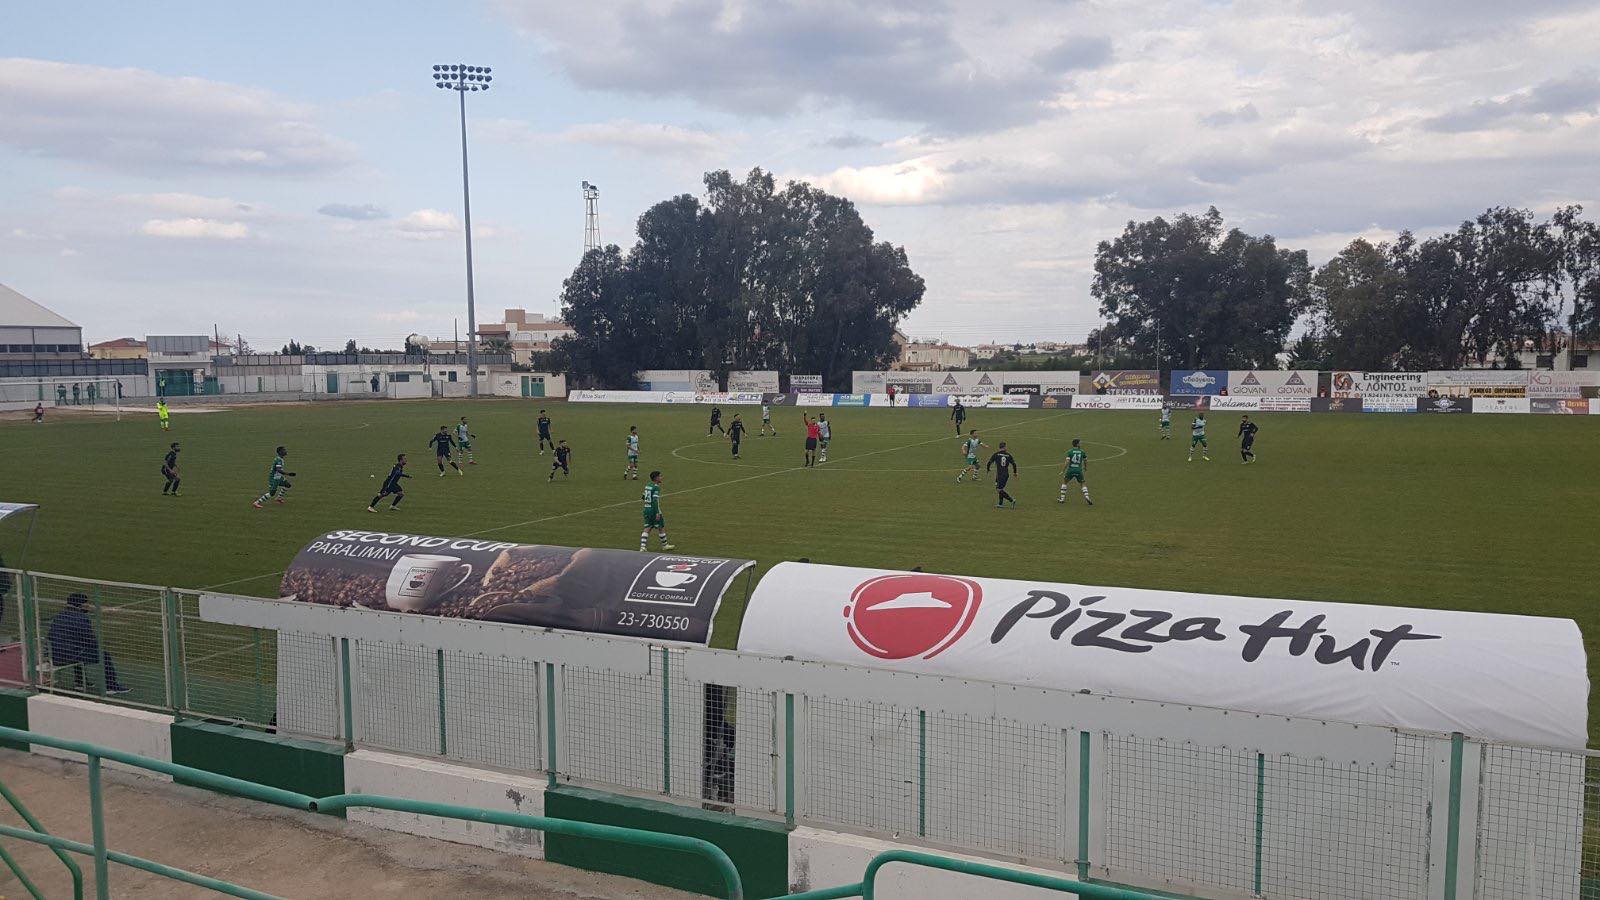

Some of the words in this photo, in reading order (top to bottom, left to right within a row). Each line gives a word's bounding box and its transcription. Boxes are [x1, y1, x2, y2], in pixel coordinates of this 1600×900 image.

[1363, 373, 1422, 382] Engineering
[1001, 456, 1007, 467] 8
[307, 541, 402, 560] PARALIMNI
[326, 529, 450, 549] SECOND
[449, 538, 520, 553] CUP
[660, 593, 694, 602] COMPANY
[617, 611, 690, 631] 23-730550
[991, 590, 1226, 653] Pizza
[1238, 610, 1443, 672] Hut
